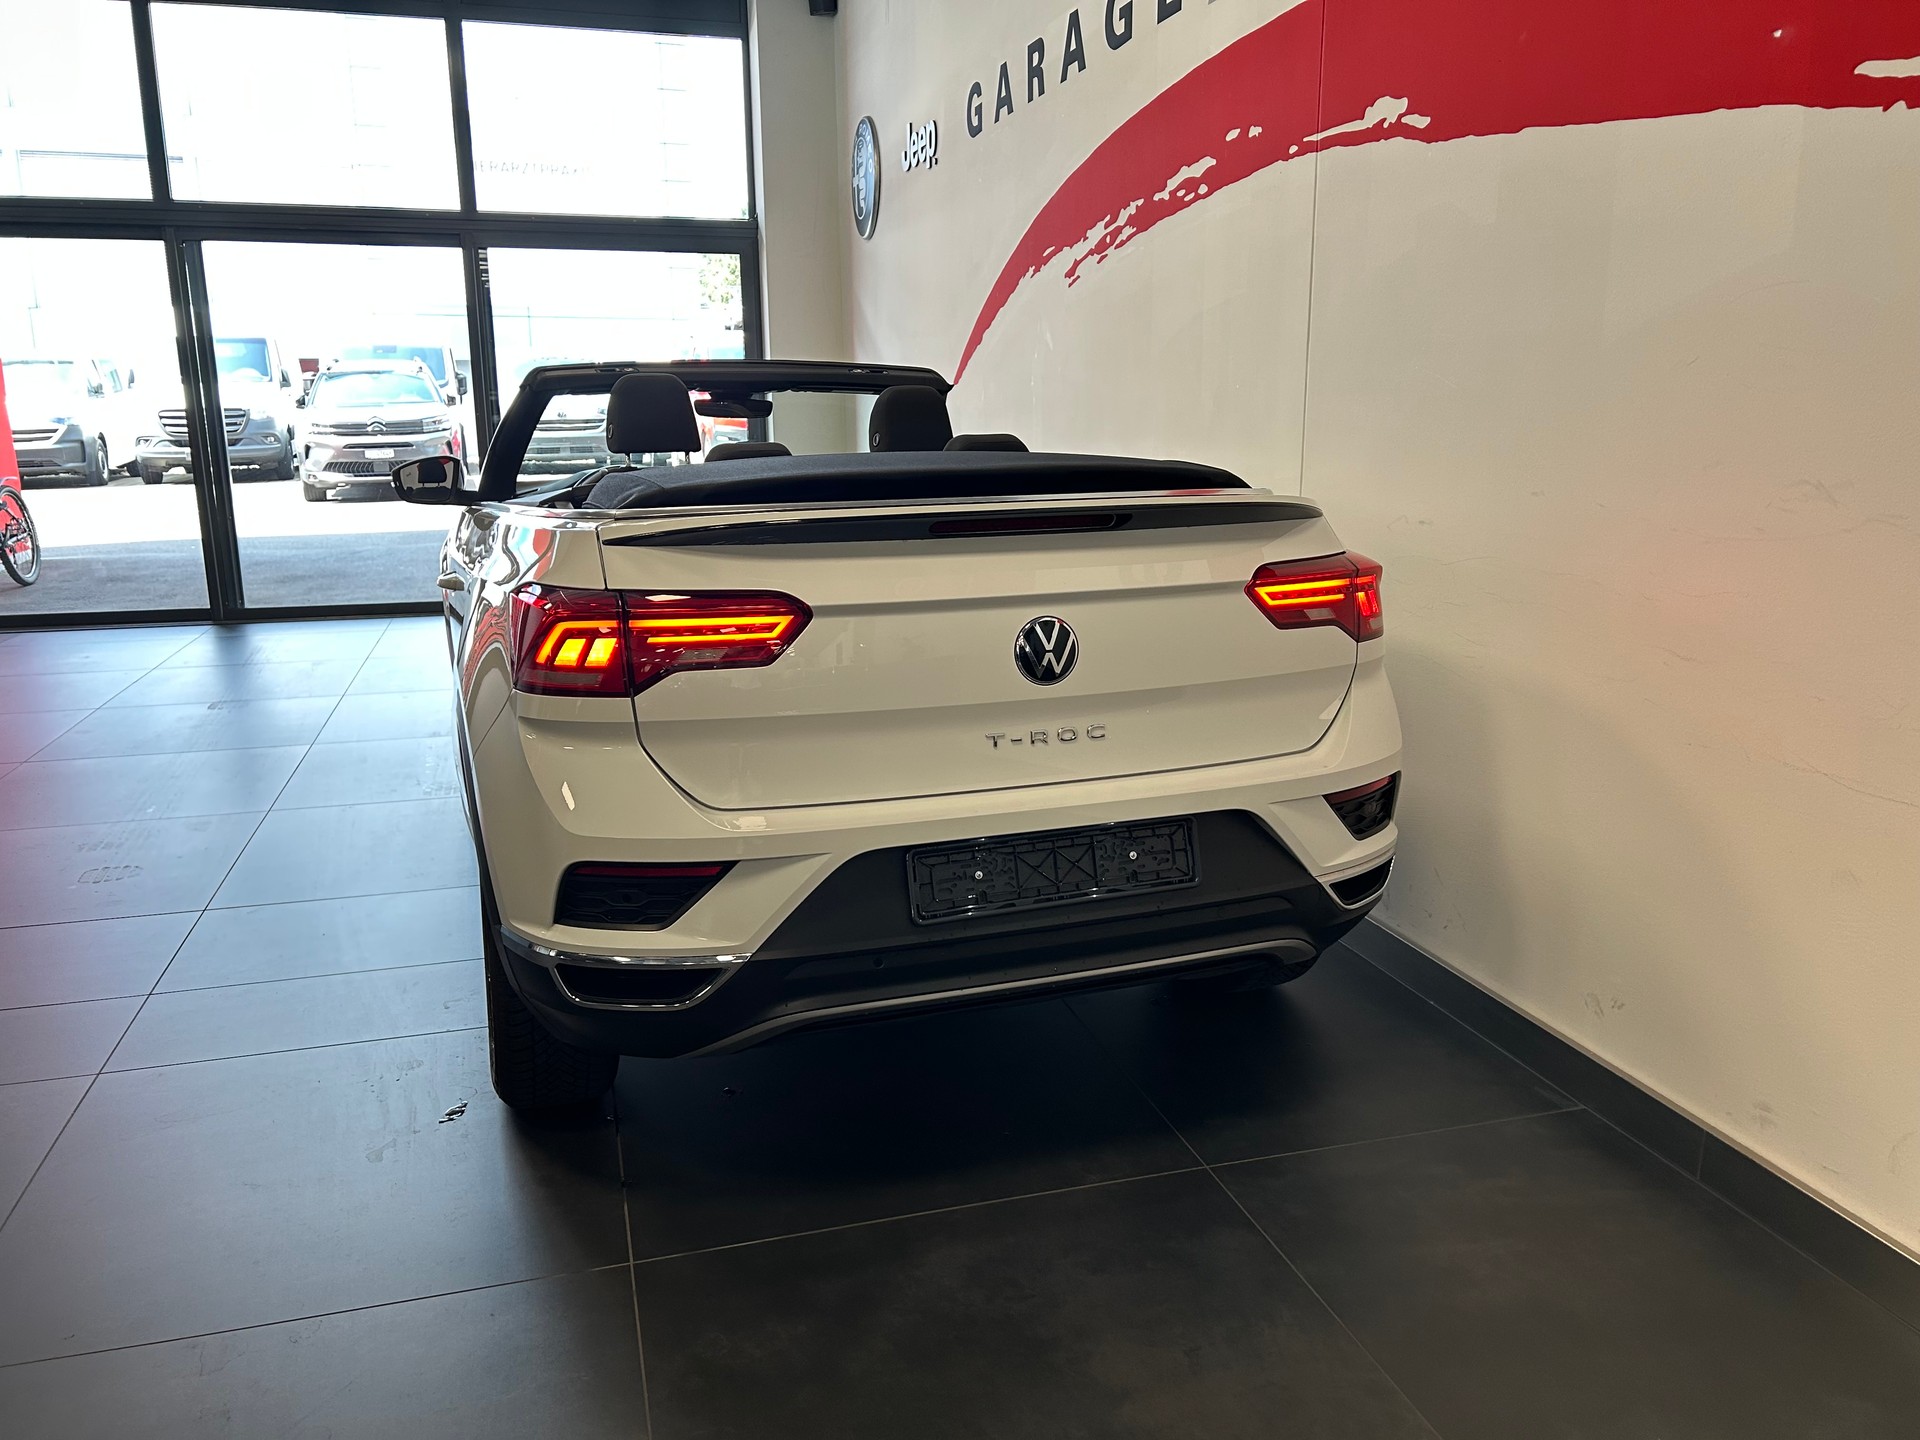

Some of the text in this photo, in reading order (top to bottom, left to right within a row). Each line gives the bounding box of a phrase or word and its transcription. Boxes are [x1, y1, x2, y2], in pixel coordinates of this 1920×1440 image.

[966, 0, 1182, 138] GARAG
[902, 119, 938, 171] Jeep
[985, 724, 1106, 749] T-ROC
